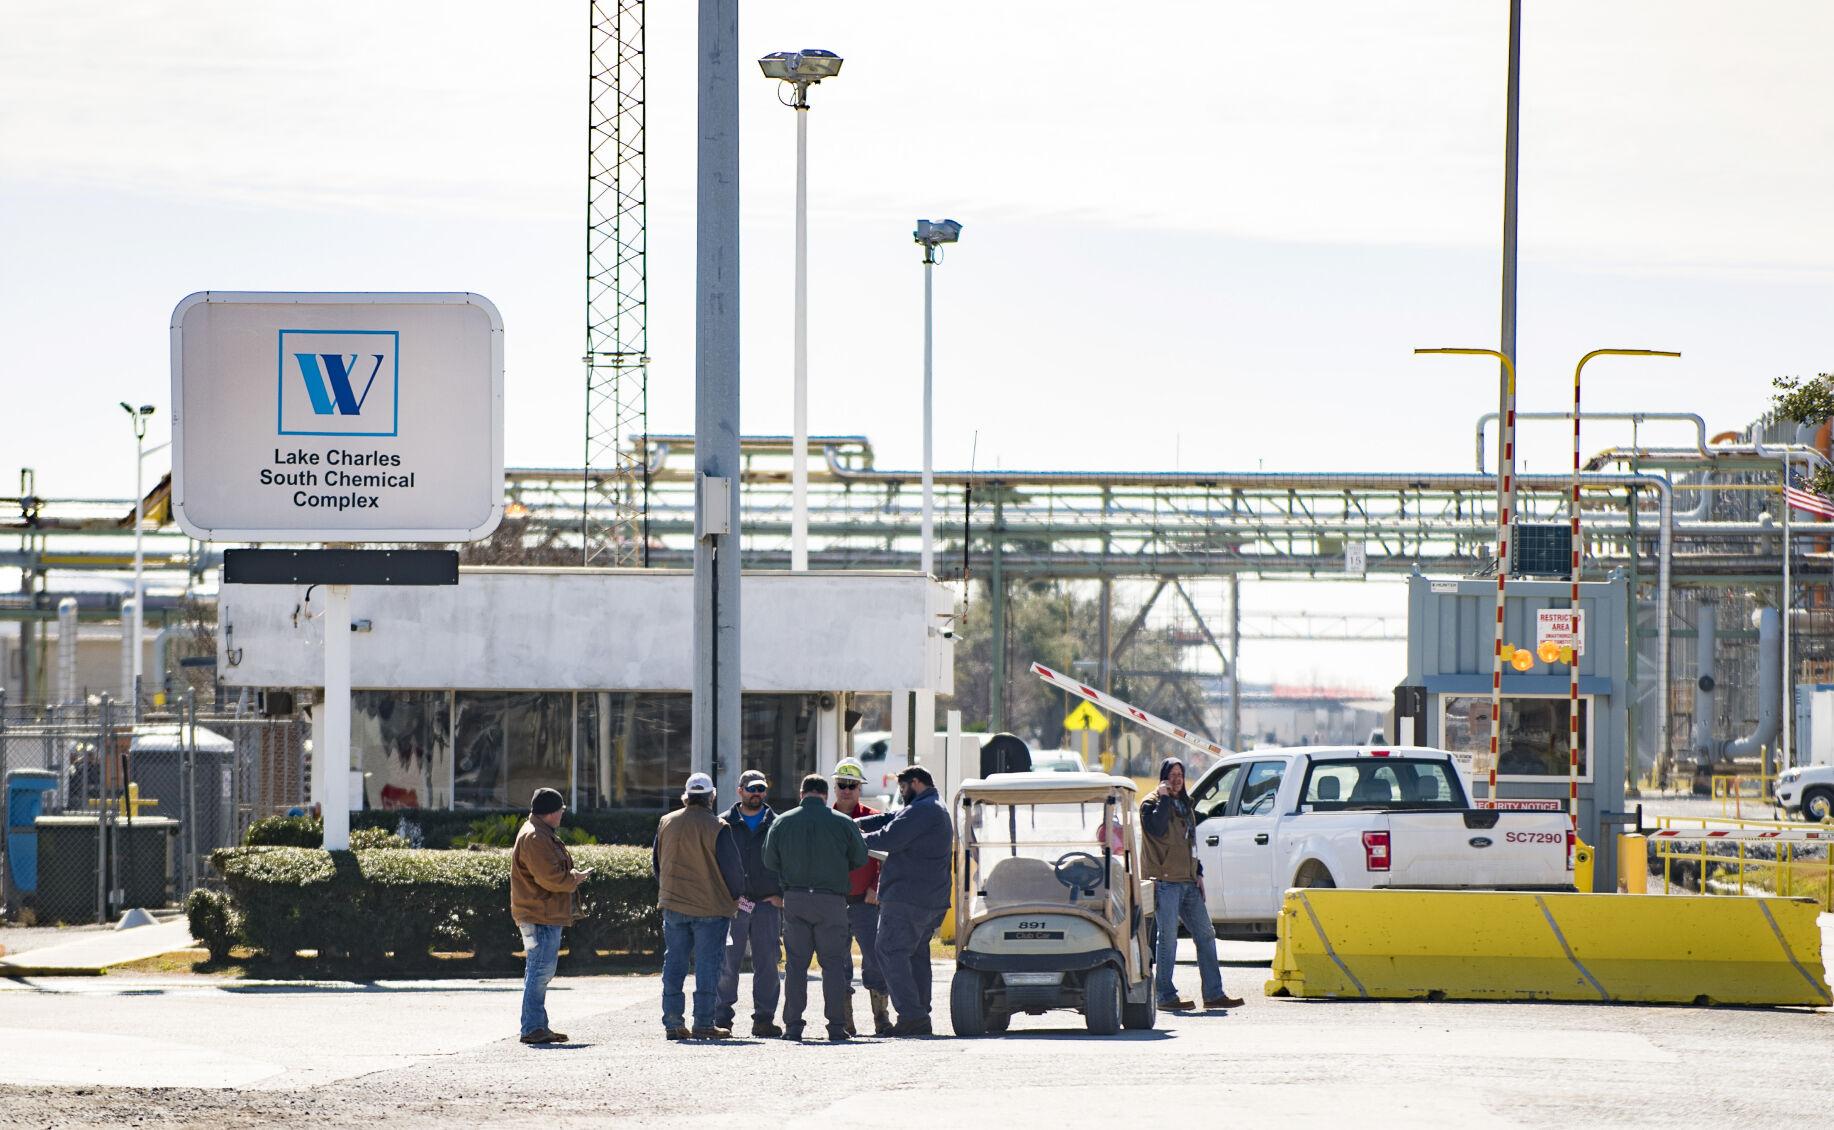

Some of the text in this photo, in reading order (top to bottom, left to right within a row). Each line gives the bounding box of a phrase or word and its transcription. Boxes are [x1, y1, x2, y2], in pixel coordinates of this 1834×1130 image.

[274, 448, 401, 467] Lake Charles
[260, 469, 415, 488] South Chemical
[293, 491, 379, 512] Complex
[1474, 802, 1557, 810] ECRITY NOTICE
[1506, 832, 1562, 844] SC7290
[1018, 921, 1046, 930] 891
